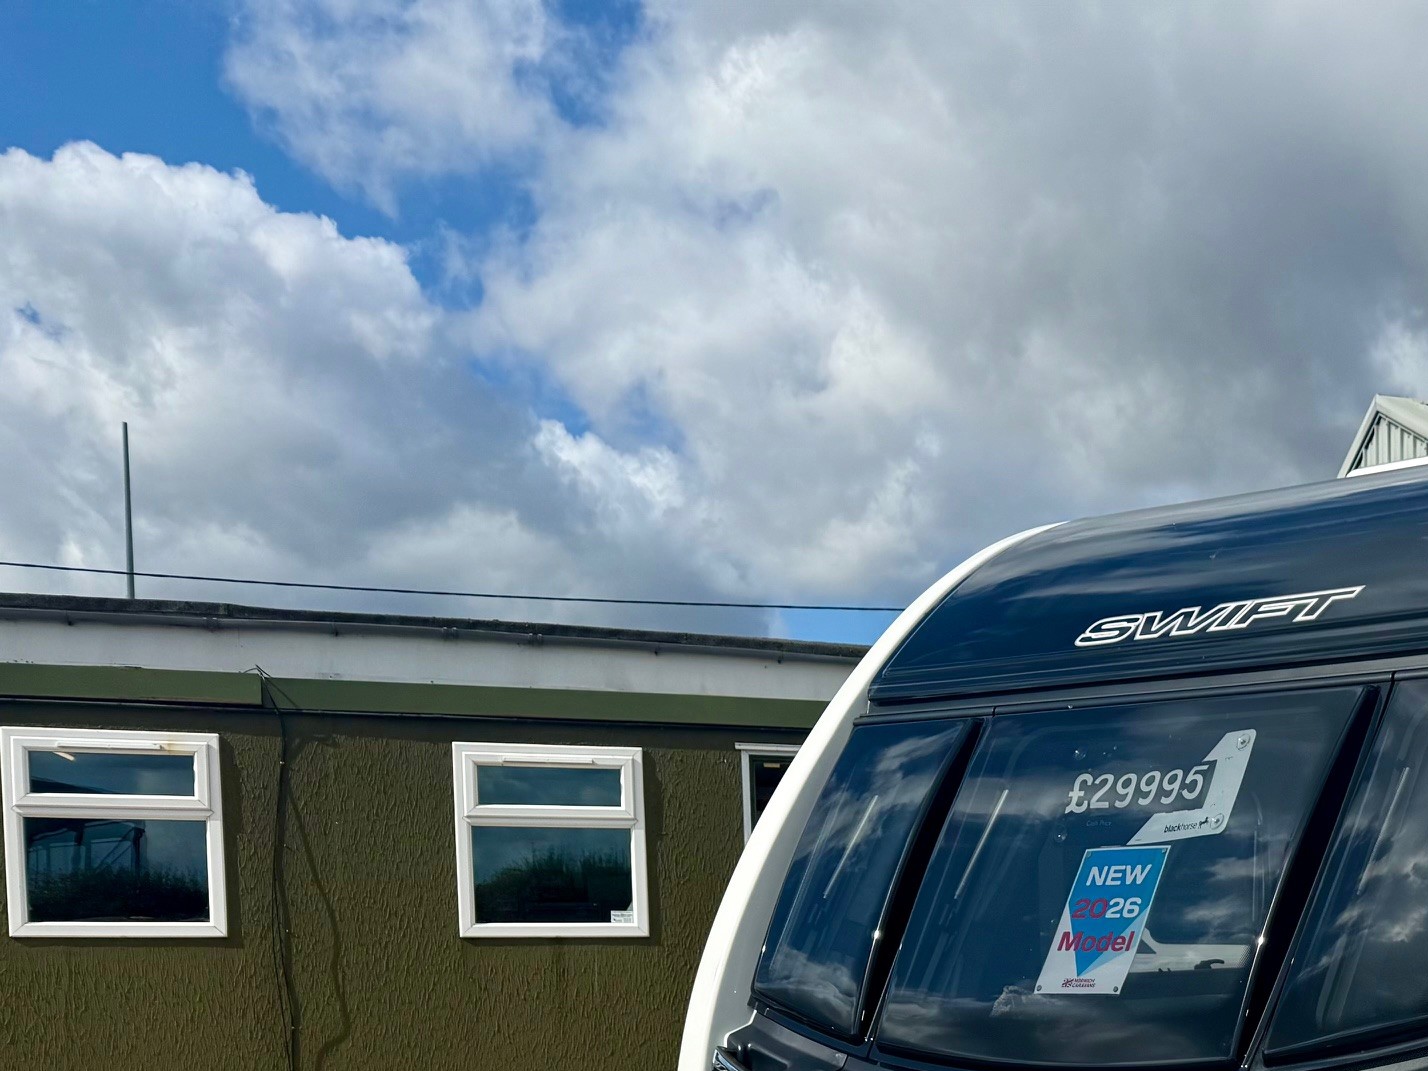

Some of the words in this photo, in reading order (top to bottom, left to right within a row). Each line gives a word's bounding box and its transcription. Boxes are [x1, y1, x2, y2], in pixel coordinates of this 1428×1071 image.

[1074, 584, 1367, 647] SWIFT
[1064, 764, 1210, 815] £29995
[1163, 822, 1199, 833] blackhorse
[1085, 864, 1153, 887] NEW
[1072, 897, 1142, 919] 2026
[1057, 931, 1136, 952] Model
